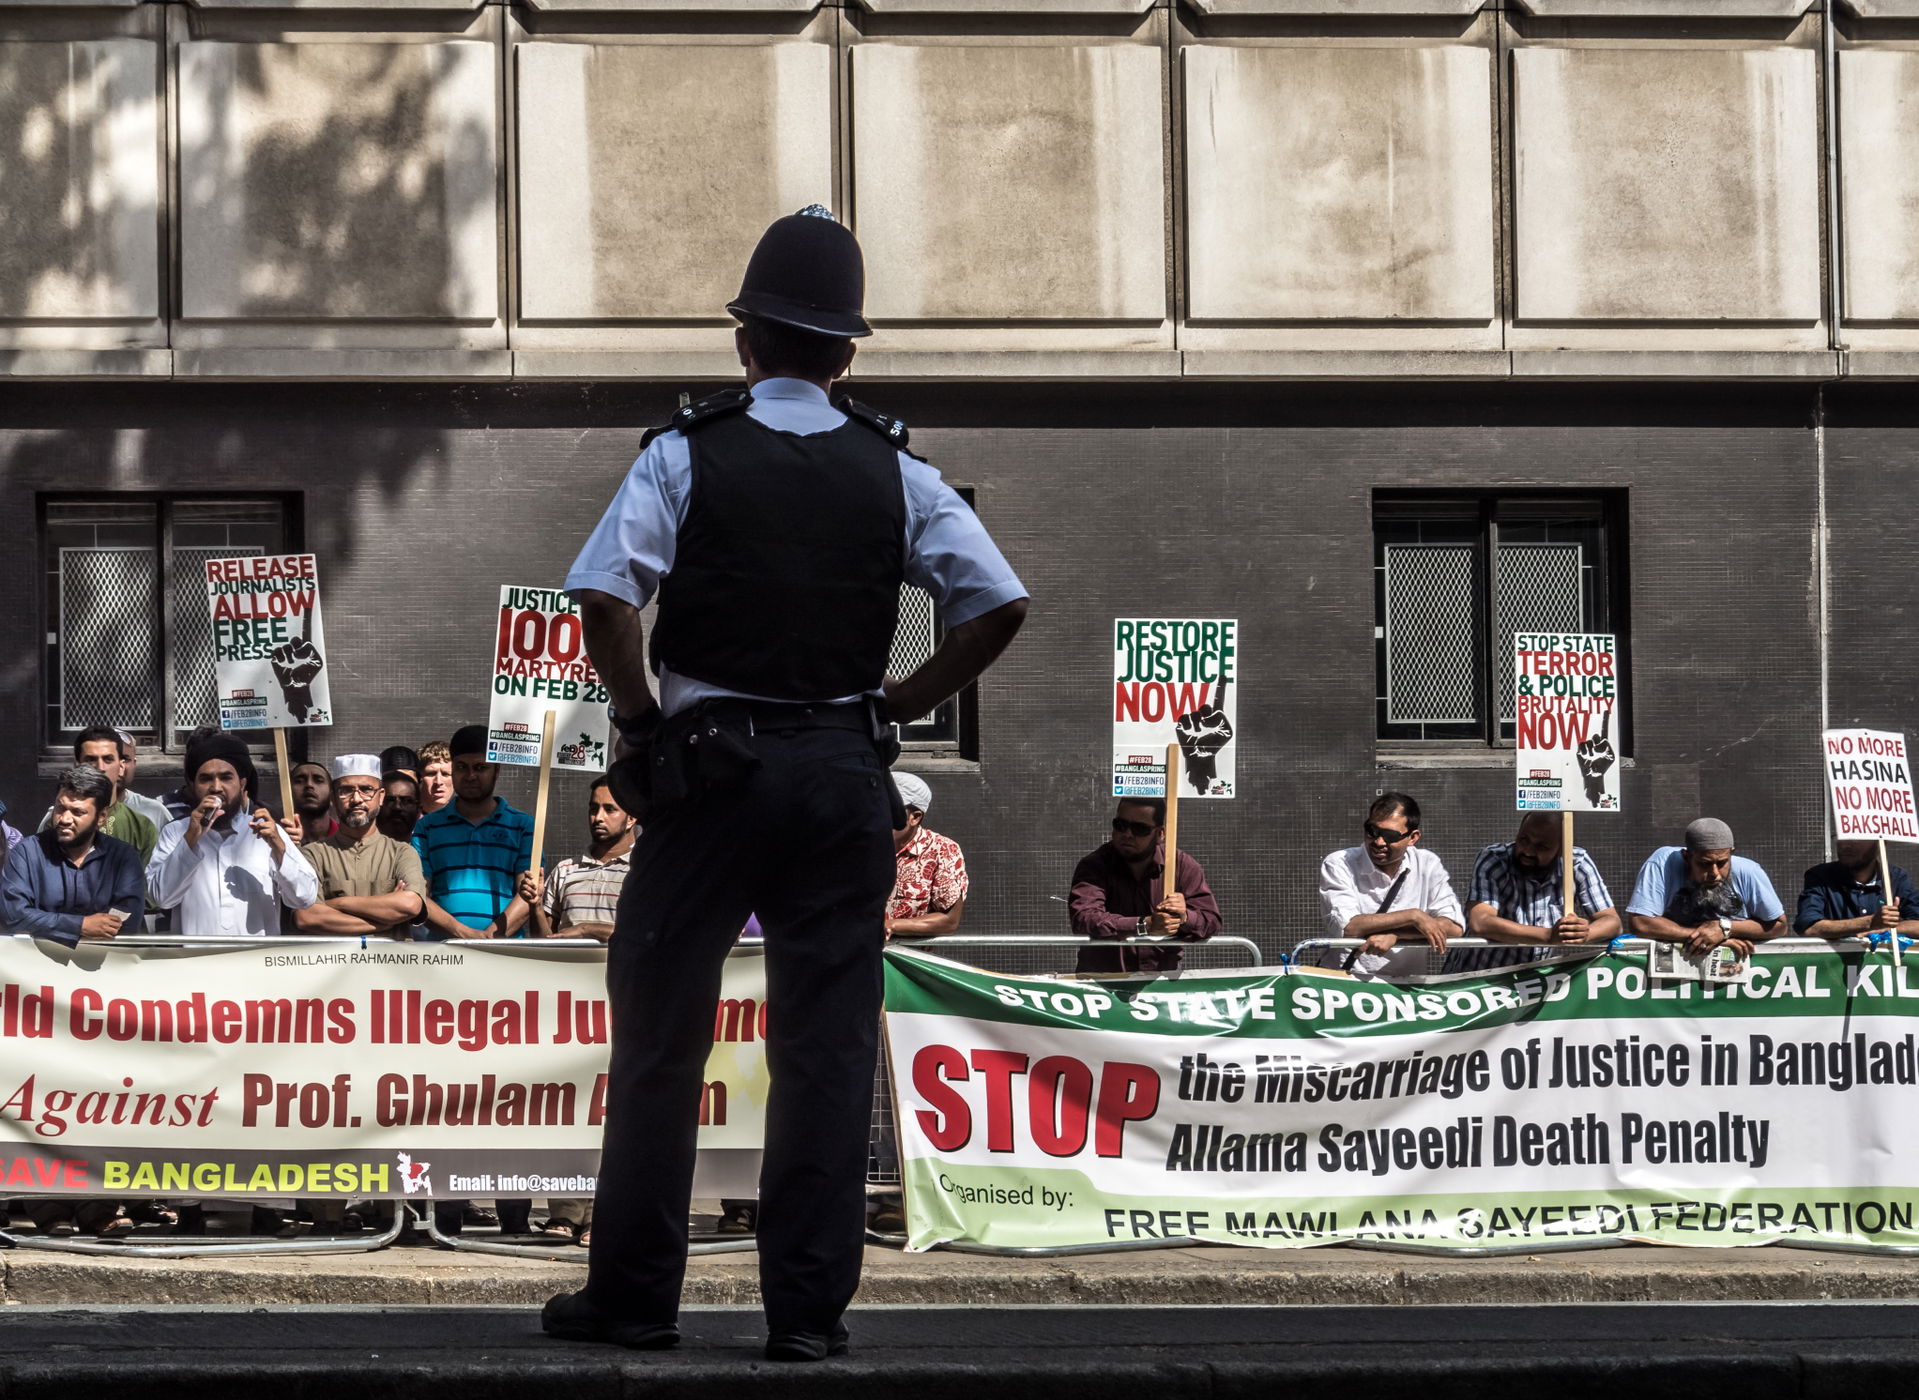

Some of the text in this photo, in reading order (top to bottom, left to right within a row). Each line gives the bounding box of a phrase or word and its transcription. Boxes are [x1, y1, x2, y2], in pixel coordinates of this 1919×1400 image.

[207, 555, 315, 582] RELEASE
[210, 577, 316, 596] JOURNALISTS
[213, 590, 316, 620] ALLOW
[213, 617, 289, 646] FREE
[498, 608, 592, 667] 100
[1117, 621, 1236, 651] RESTORE
[1518, 635, 1613, 653] STOP STATE
[216, 642, 274, 662] PRESS
[1518, 651, 1614, 677] TERROR
[496, 657, 603, 684] MARTYRE
[1117, 650, 1235, 683] JUSTICE
[494, 674, 610, 704] ON FEB 28
[1518, 674, 1615, 697] & POLICE
[1115, 682, 1211, 723] NOW
[1518, 695, 1615, 714] BRUTALITY
[491, 731, 540, 742] #BANGLASPRING
[504, 723, 528, 733] #FEB28
[1518, 712, 1591, 750] NOW
[1828, 737, 1904, 757] NO MORE
[1830, 760, 1907, 784] HASINA
[1835, 786, 1913, 814] NO MORE
[1840, 814, 1917, 837] BAKSHALL
[264, 953, 464, 967] BISMILLAHIR RAHMANIR RAHIM
[994, 984, 1112, 1018] STOP
[1130, 987, 1277, 1023] STATE
[1291, 972, 1572, 1022] SPONSORED
[0, 983, 55, 1039] ld
[69, 987, 356, 1044] Condemns
[370, 989, 539, 1052] Illegal
[1178, 1033, 1919, 1103] the Miscarriage of Justice in Banglad
[0, 1073, 218, 1137] Against
[242, 1073, 362, 1128] Prof.
[376, 1073, 577, 1128] Ghulam
[912, 1044, 1161, 1159] STOP
[1165, 1111, 1770, 1177] Allama Sayeedi Death Penalty
[0, 1157, 390, 1193] AVE BANGLADESH
[449, 1174, 598, 1192] Email: info@saveba
[1042, 1186, 1073, 1211] by:
[1104, 1208, 1209, 1238] FREE
[1457, 1204, 1640, 1239] SAYEEDI
[1650, 1201, 1913, 1235] FEDERATION
